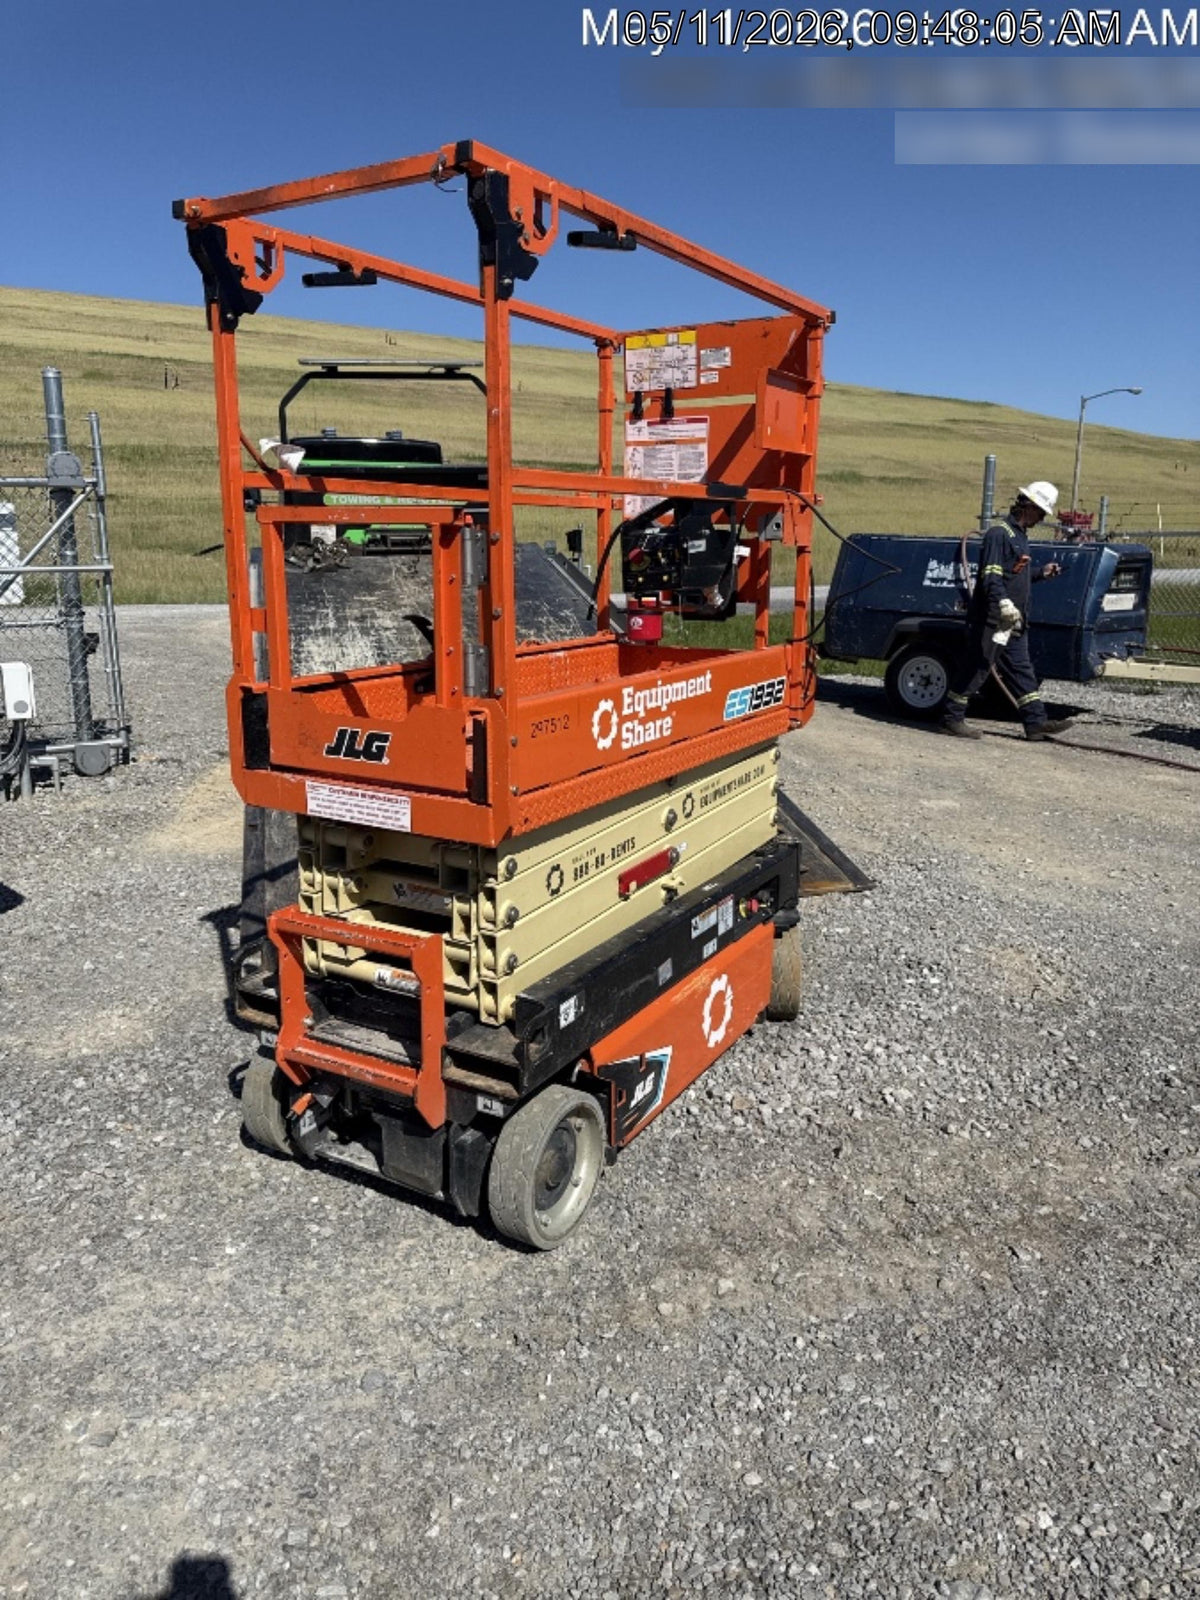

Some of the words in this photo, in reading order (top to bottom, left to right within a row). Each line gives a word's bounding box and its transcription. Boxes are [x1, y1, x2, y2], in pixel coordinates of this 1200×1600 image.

[622, 669, 712, 718] Equipment
[323, 726, 392, 765] JLG
[621, 715, 673, 750] Share
